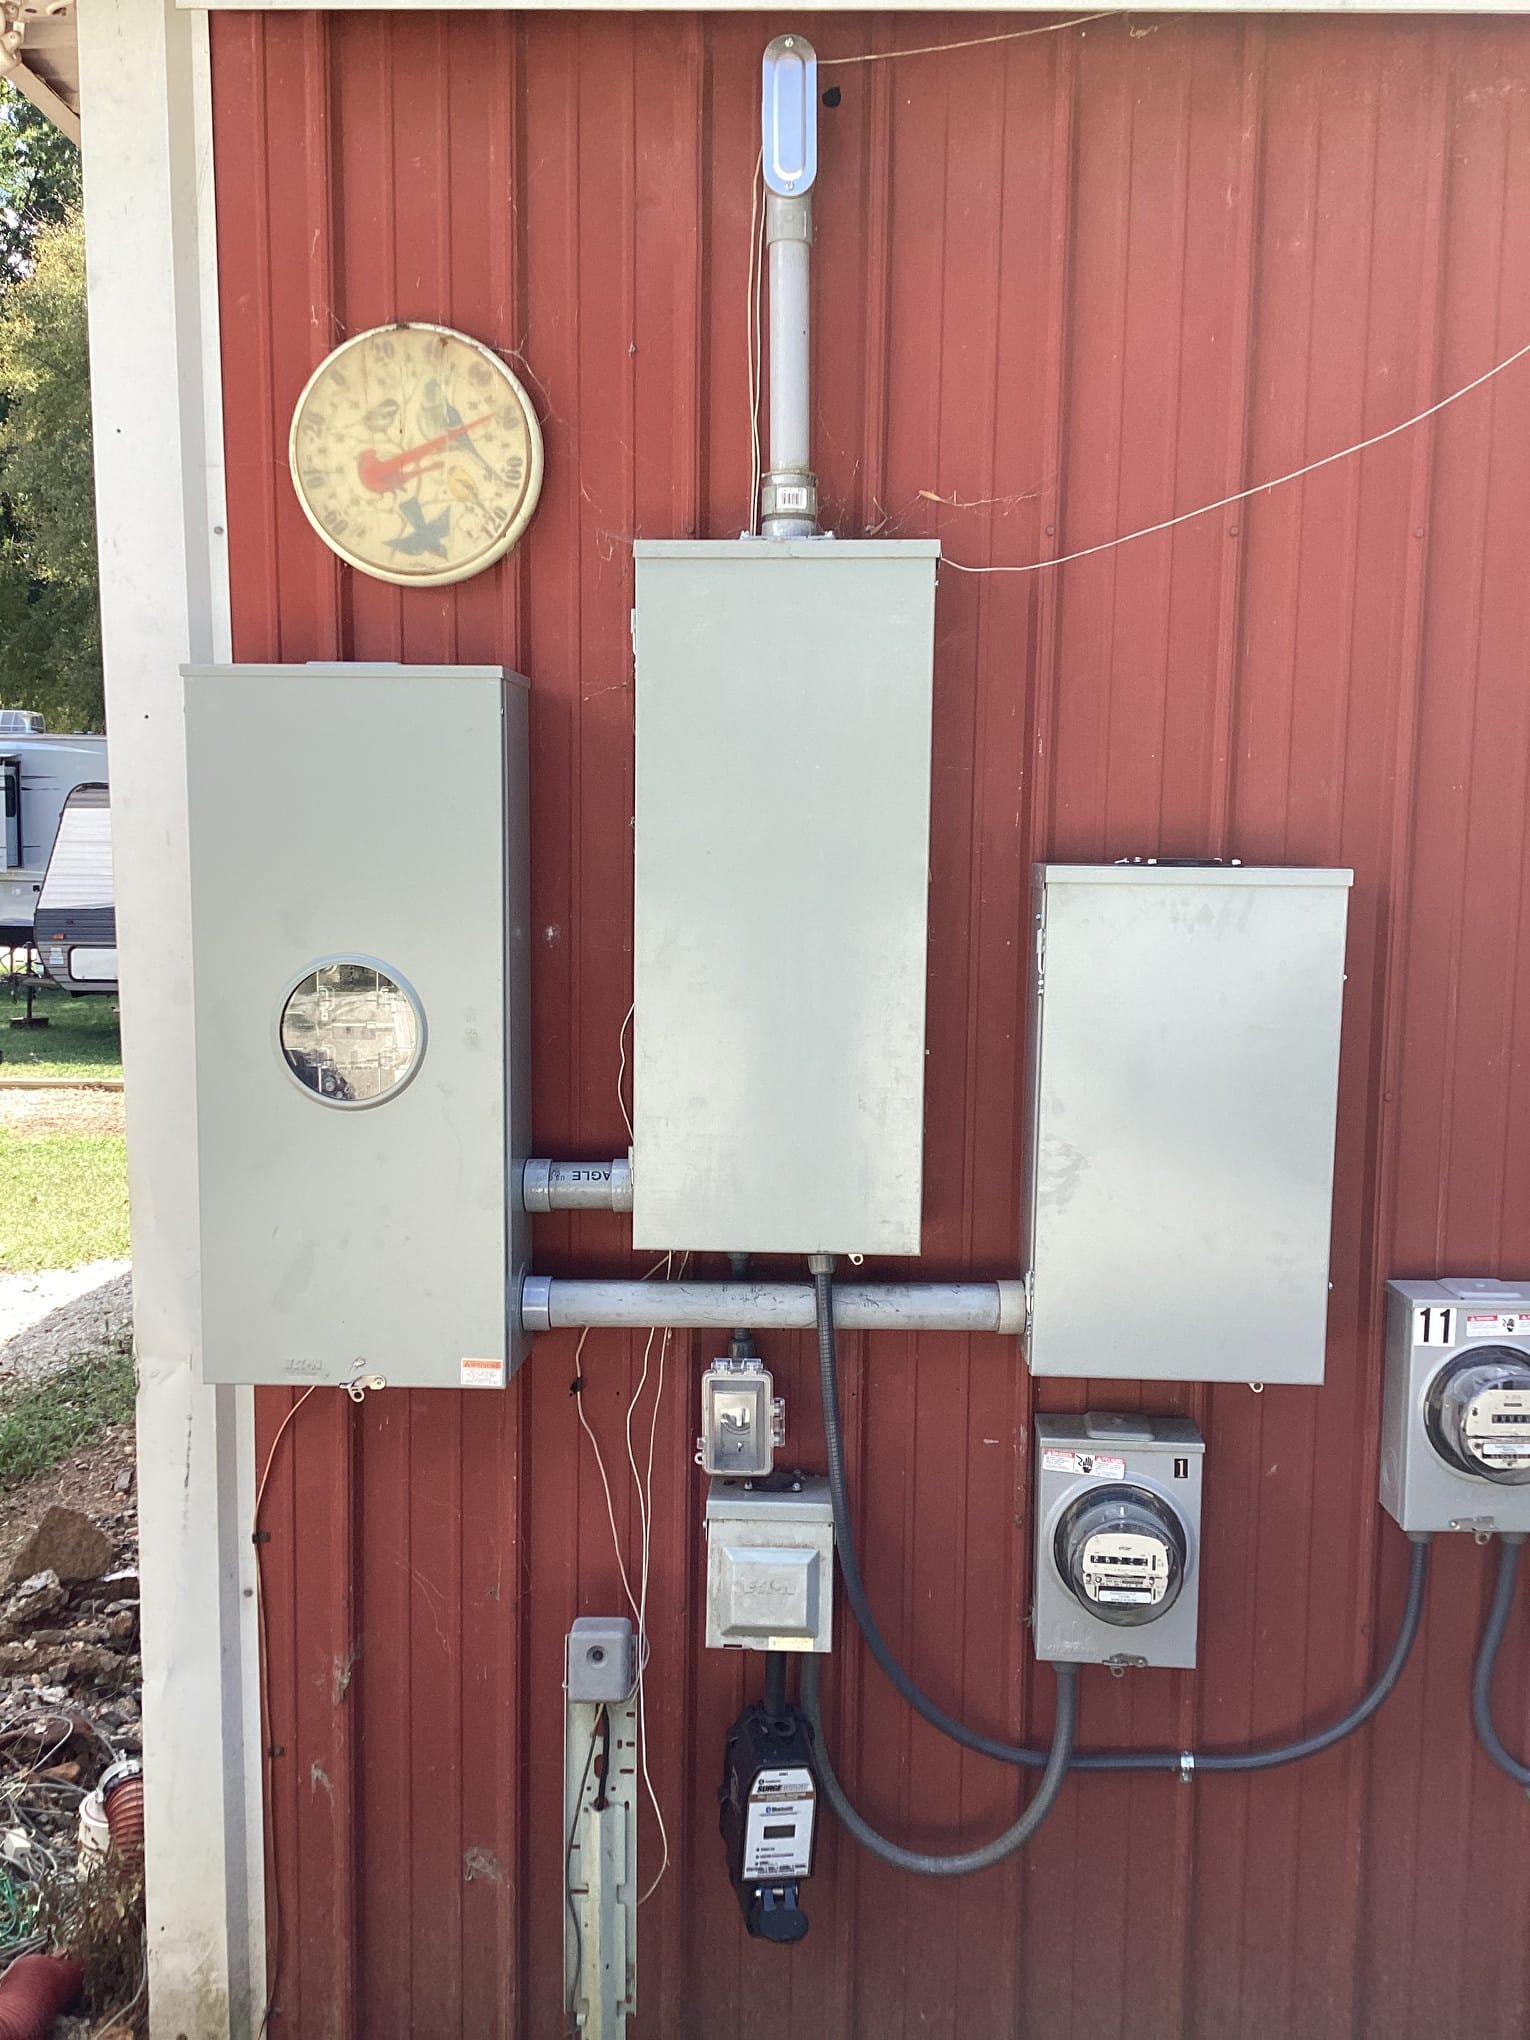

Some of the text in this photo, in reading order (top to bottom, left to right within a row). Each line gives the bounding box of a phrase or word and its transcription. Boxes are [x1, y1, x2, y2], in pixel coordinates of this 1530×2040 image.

[504, 456, 524, 490] 100
[481, 506, 508, 539] 120
[572, 1170, 611, 1181] AGLE
[1420, 1307, 1451, 1344] 11
[1177, 1460, 1185, 1478] 1
